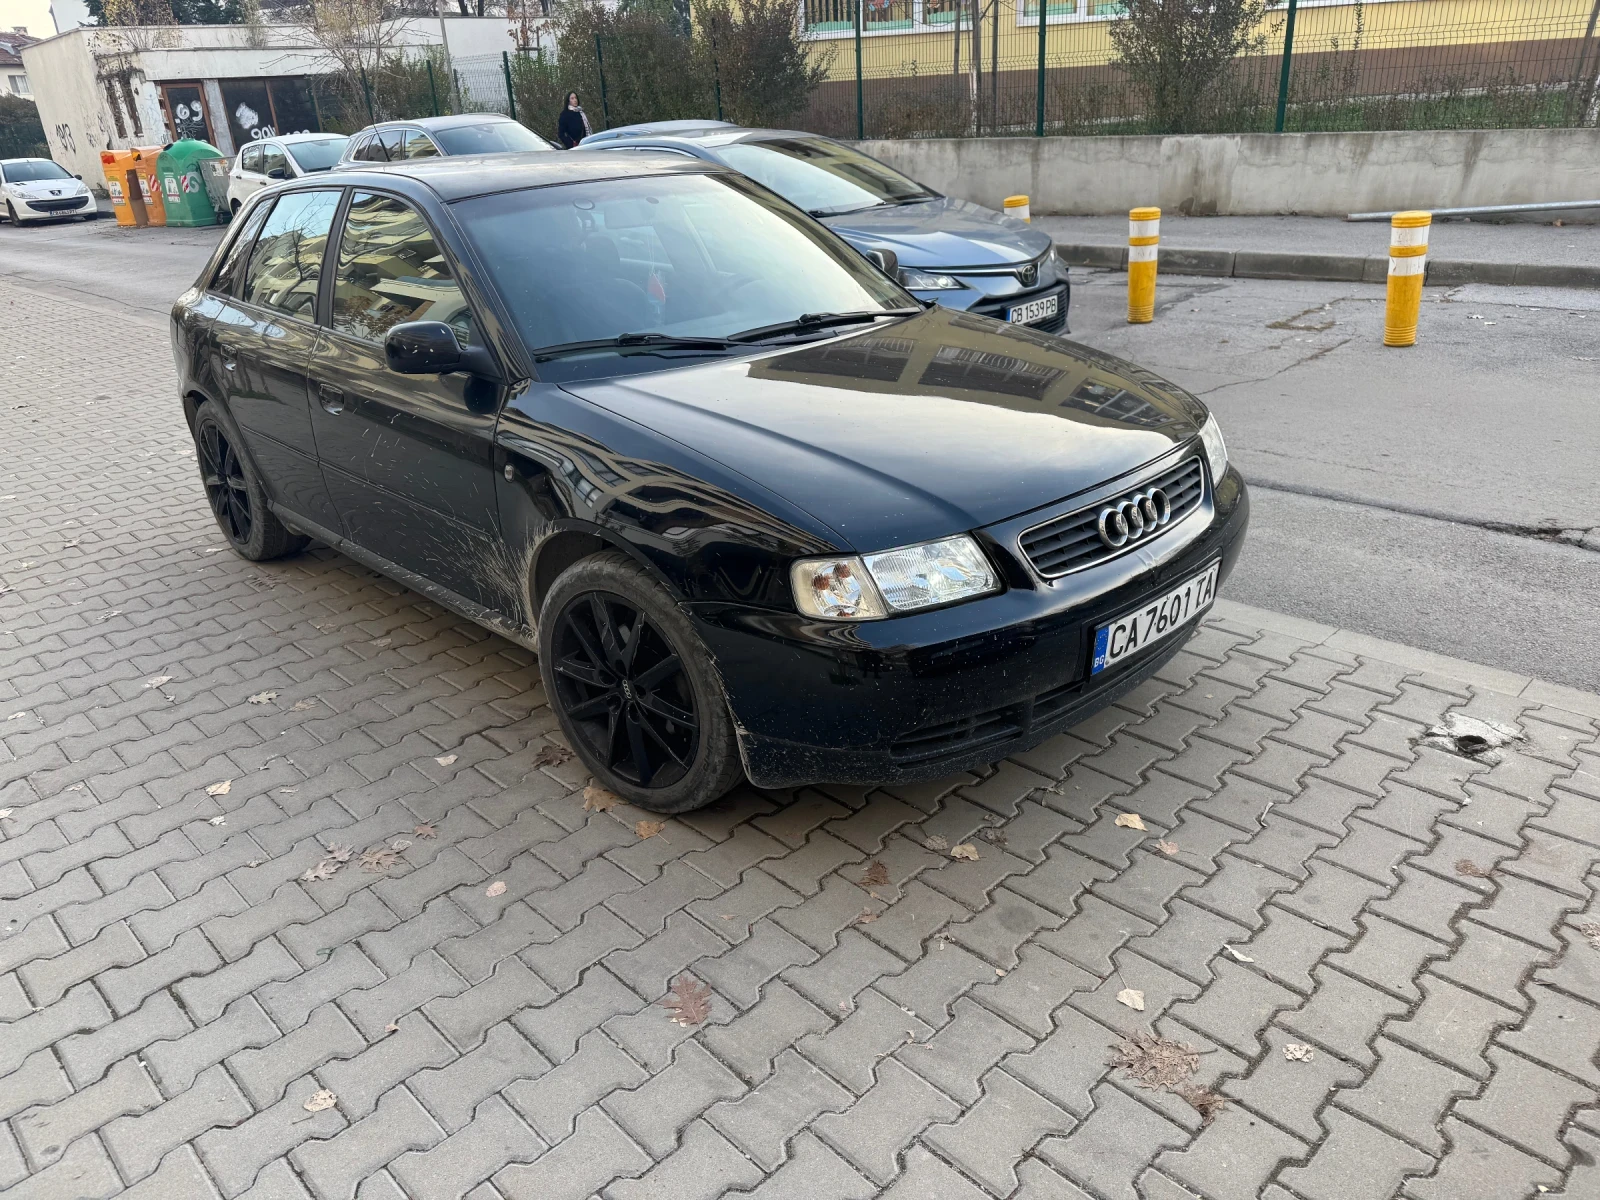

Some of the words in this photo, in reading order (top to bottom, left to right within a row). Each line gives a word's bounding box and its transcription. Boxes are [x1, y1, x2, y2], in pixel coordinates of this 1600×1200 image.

[1011, 307, 1023, 323] CB
[1025, 301, 1045, 320] 1539
[1046, 298, 1057, 314] PB
[1110, 617, 1138, 659] CA
[1142, 586, 1191, 643] 7601
[1195, 571, 1213, 610] TA
[1094, 655, 1105, 667] BG
